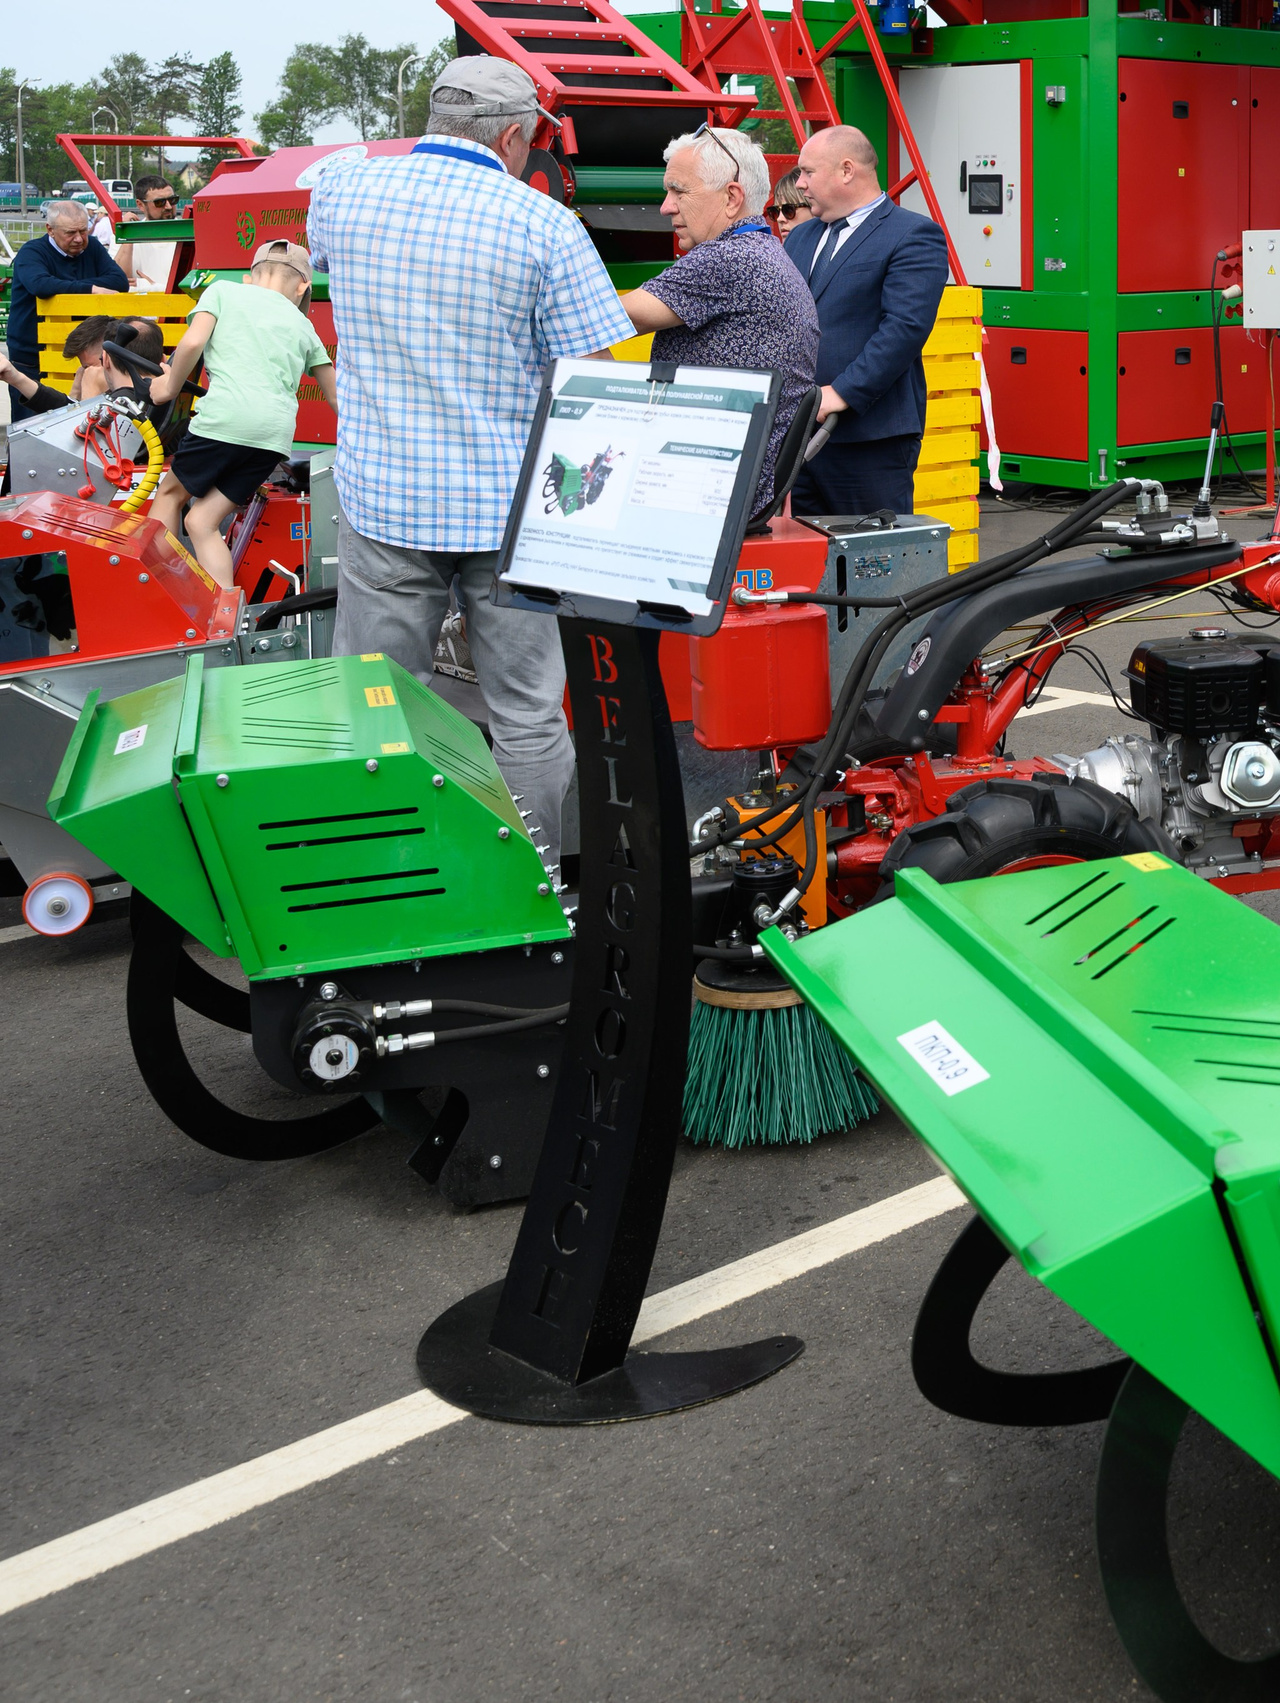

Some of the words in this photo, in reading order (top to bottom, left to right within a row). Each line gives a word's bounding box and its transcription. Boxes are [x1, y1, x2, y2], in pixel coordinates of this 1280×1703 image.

[259, 208, 309, 227] ЭКСПЕРИМ
[295, 232, 309, 249] ЗА
[297, 384, 327, 401] БЛИК
[605, 385, 649, 396] ПОДТАЛКИВАТЕЛЬ
[733, 568, 774, 591] ПВ
[915, 1034, 968, 1081] ПКП-0,9
